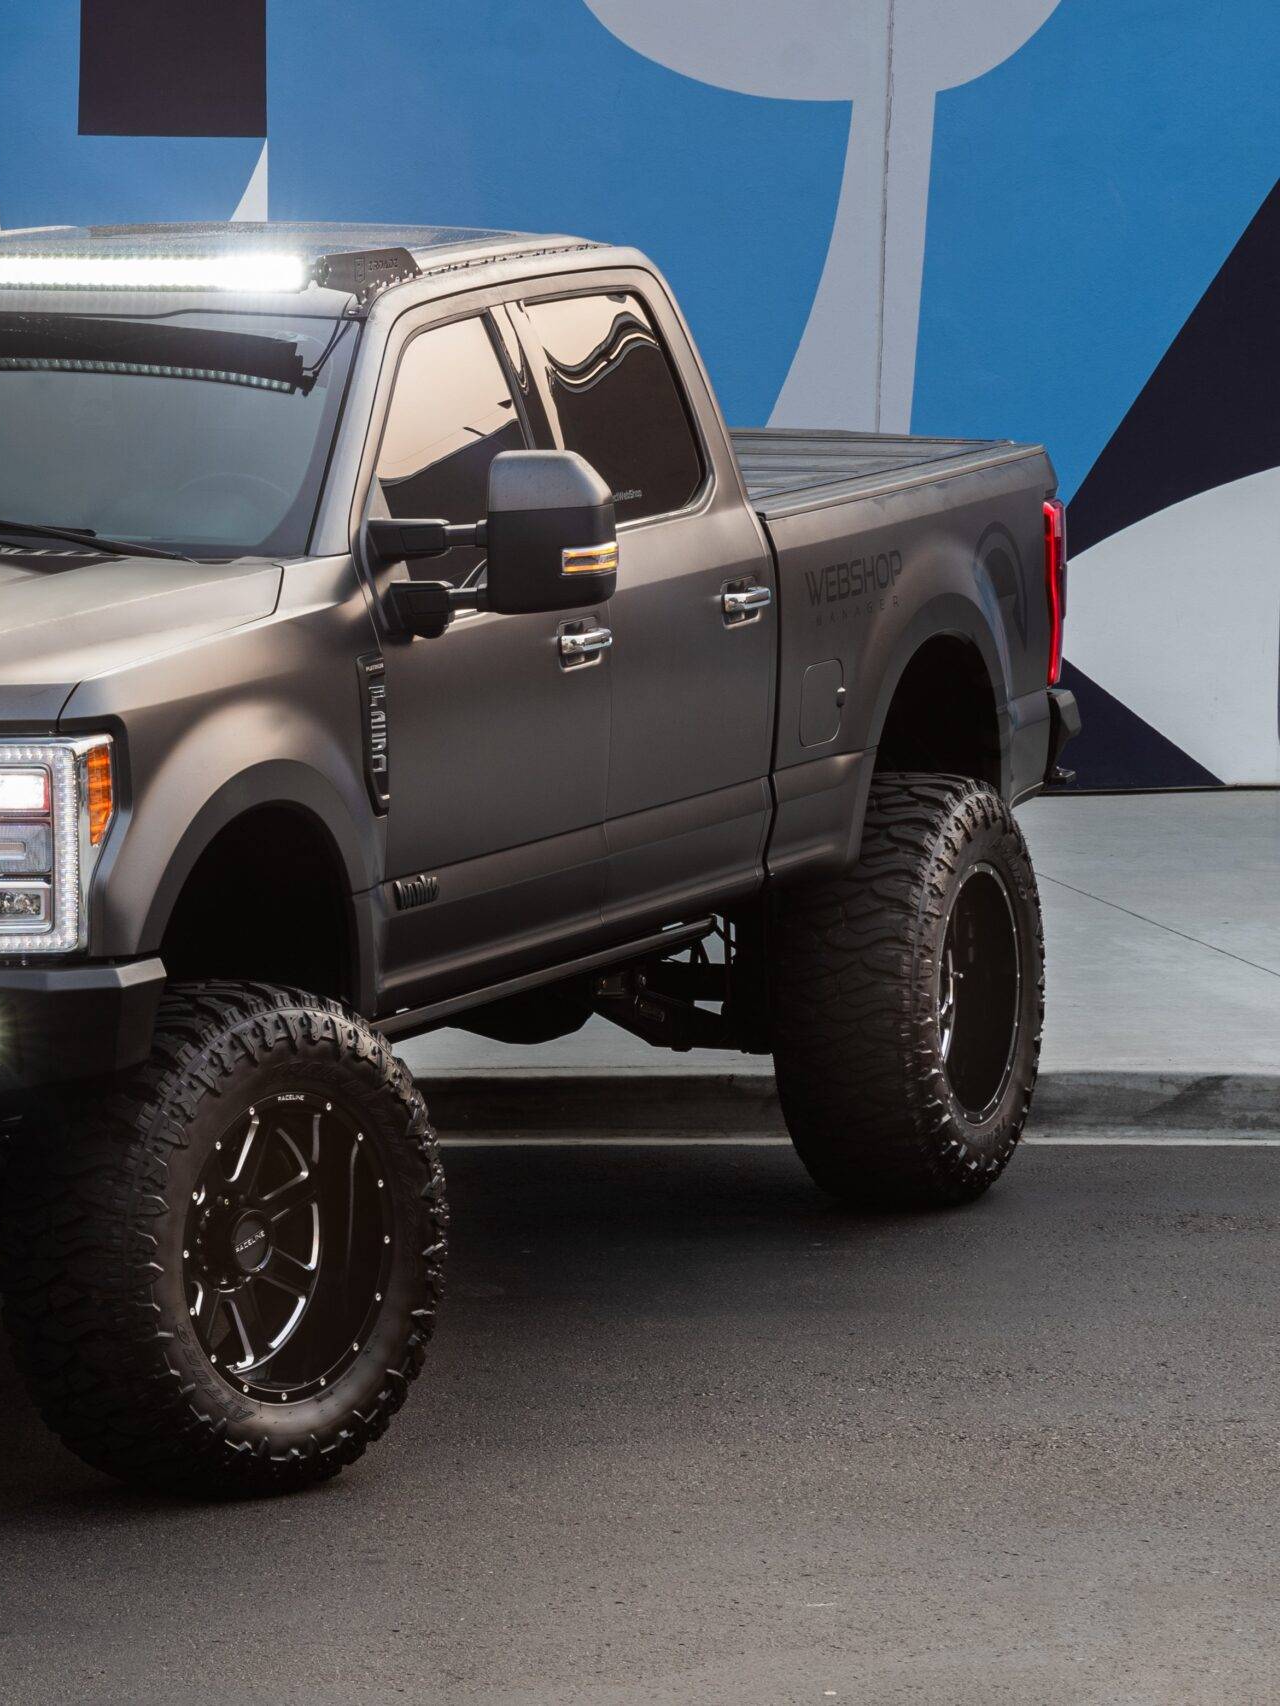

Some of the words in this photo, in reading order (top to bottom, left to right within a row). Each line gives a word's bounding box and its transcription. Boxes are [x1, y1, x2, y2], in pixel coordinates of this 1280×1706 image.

[804, 549, 903, 607] WEBSHOP
[277, 1094, 305, 1102] RACELINE
[235, 1230, 266, 1253] RACELINE
